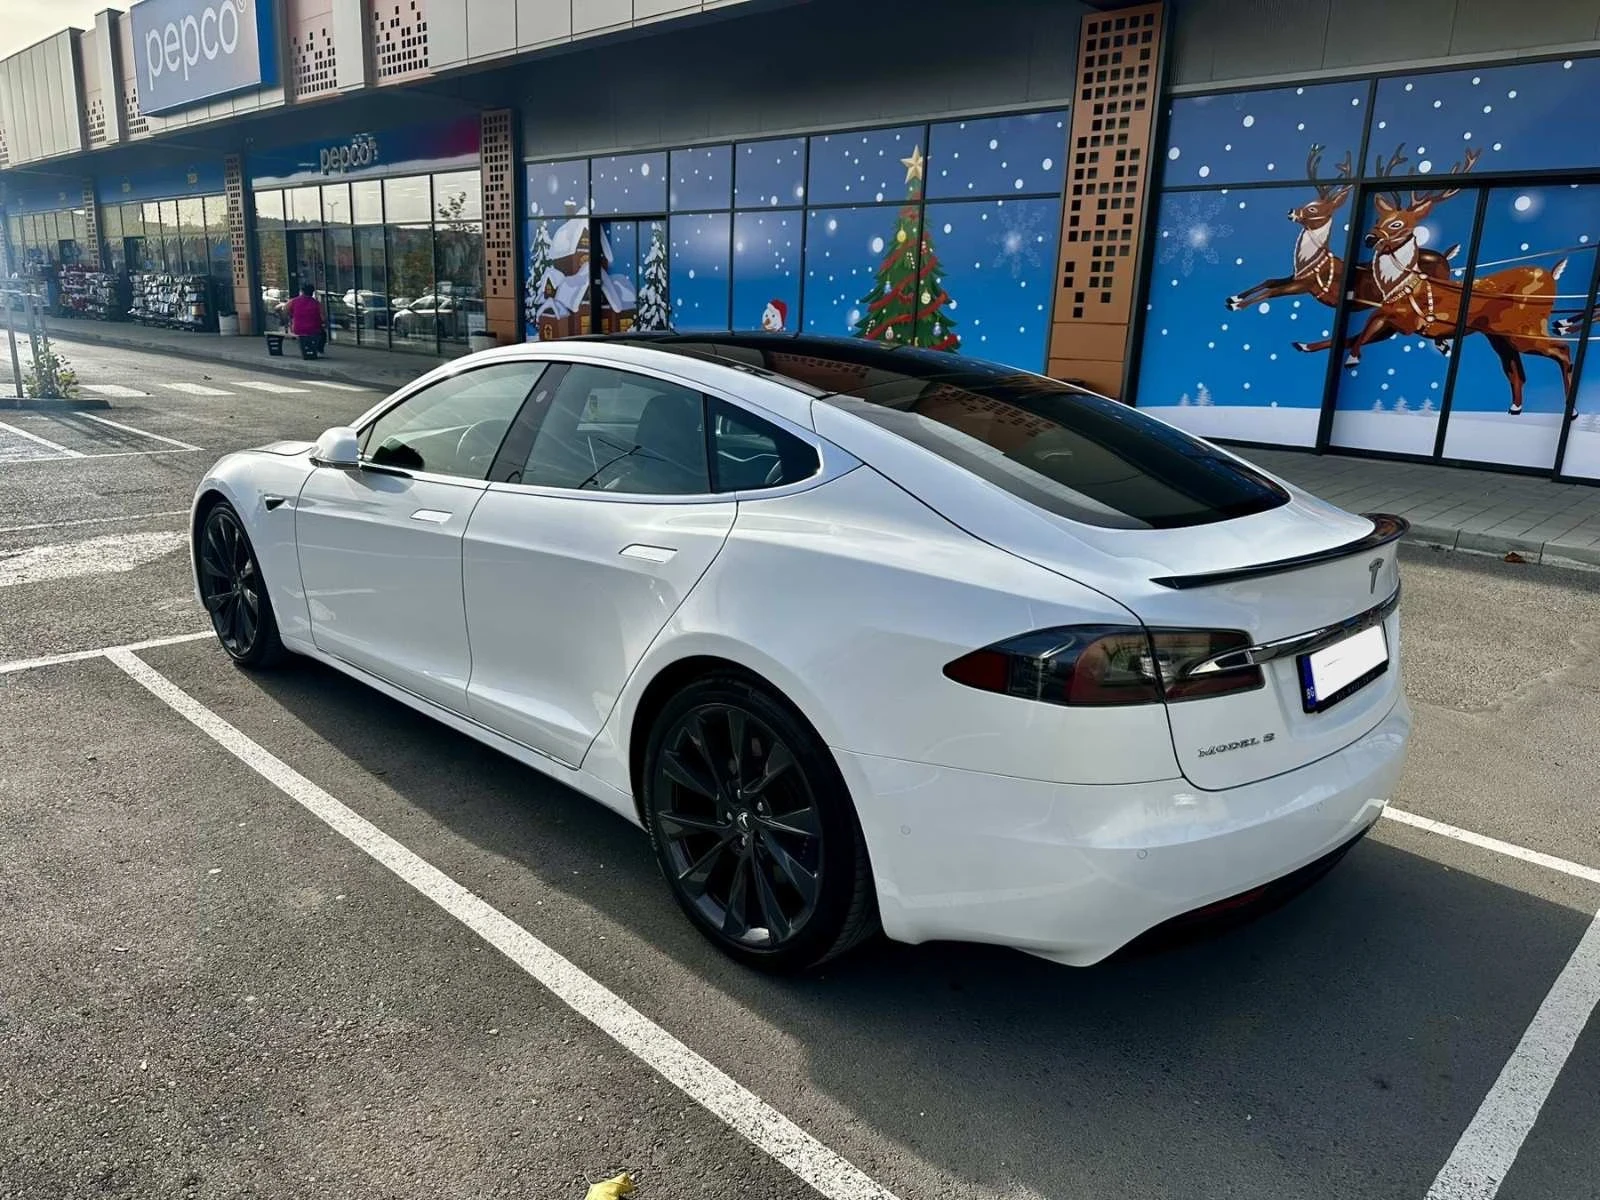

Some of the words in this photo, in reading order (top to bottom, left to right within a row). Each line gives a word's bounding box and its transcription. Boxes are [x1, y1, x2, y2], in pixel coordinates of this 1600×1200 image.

[145, 0, 238, 91] pepco
[320, 143, 370, 175] pepco
[1198, 738, 1260, 757] MODEL
[1263, 733, 1275, 742] S
